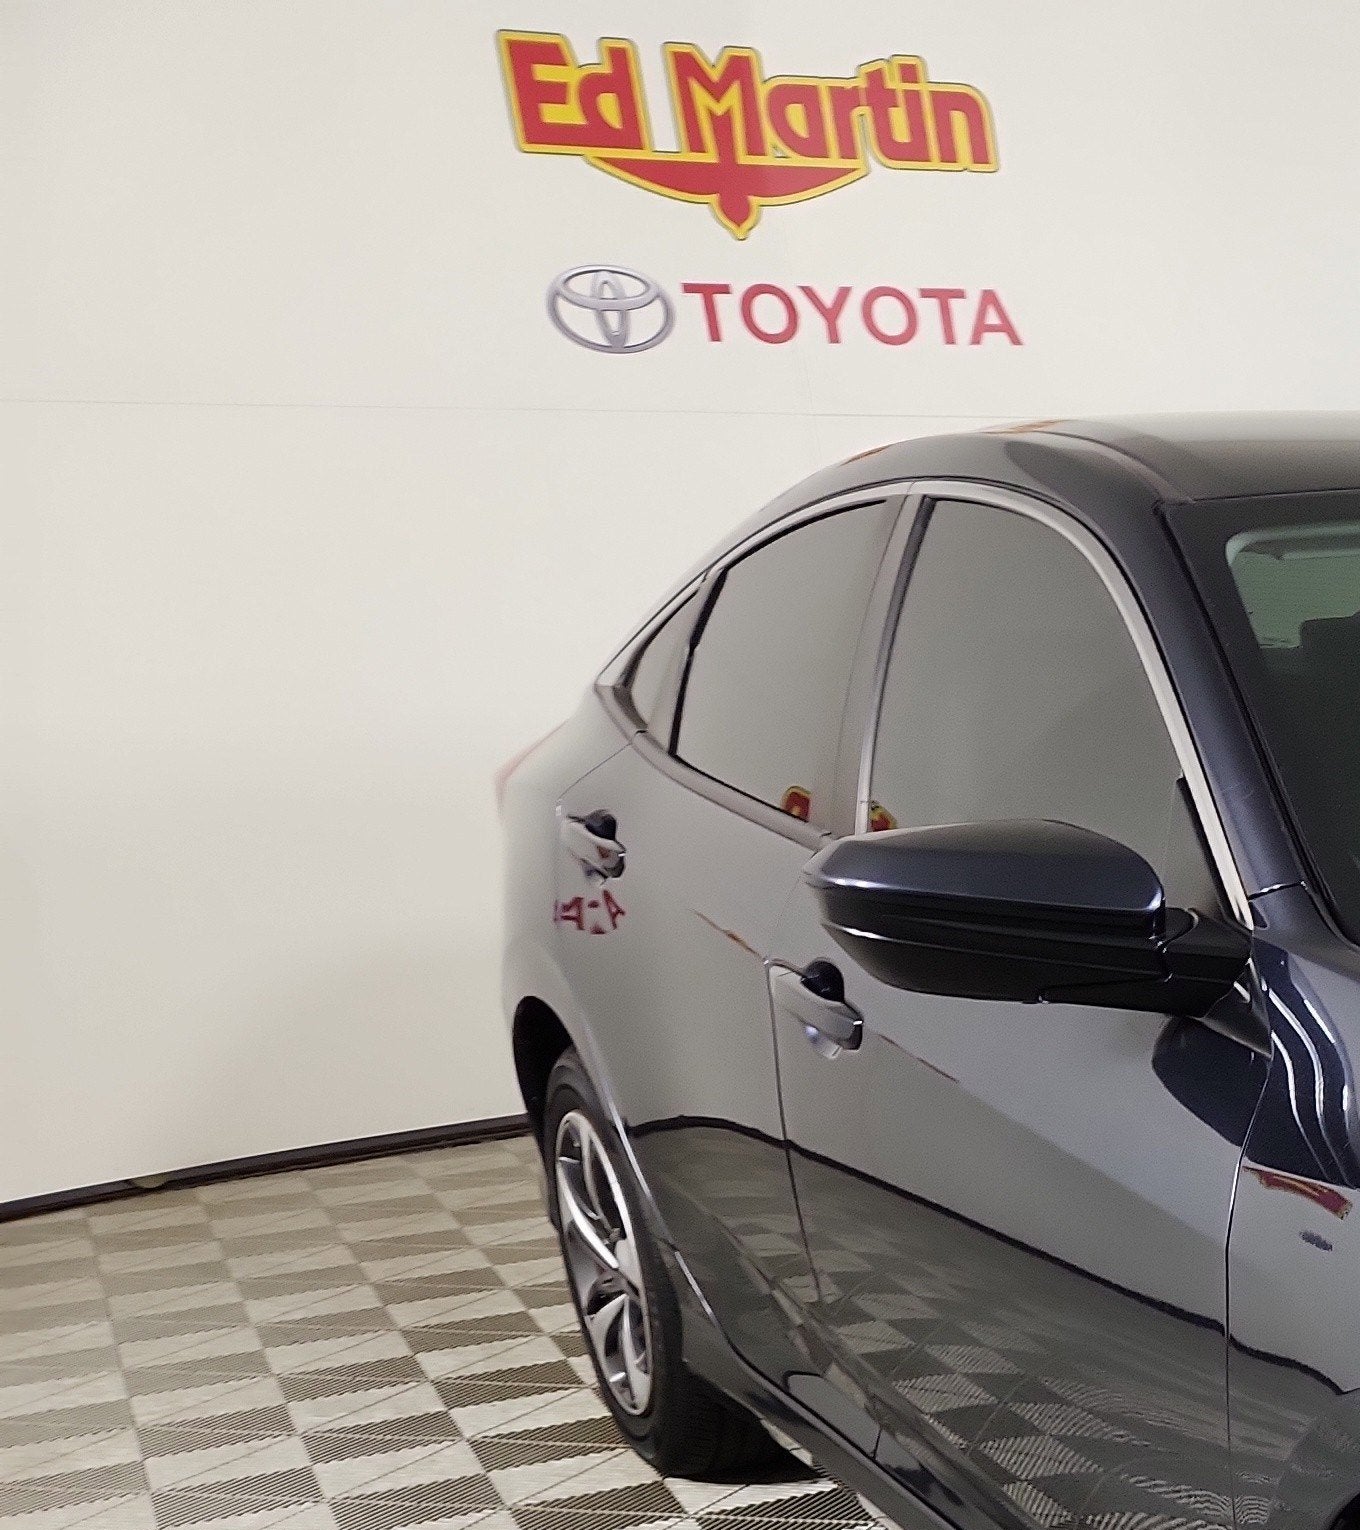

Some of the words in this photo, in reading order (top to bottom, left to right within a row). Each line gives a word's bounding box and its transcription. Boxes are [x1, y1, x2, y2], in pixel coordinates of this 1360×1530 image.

[499, 31, 652, 154] Ed
[665, 45, 996, 168] Martin
[681, 282, 1024, 346] TOYOTA
